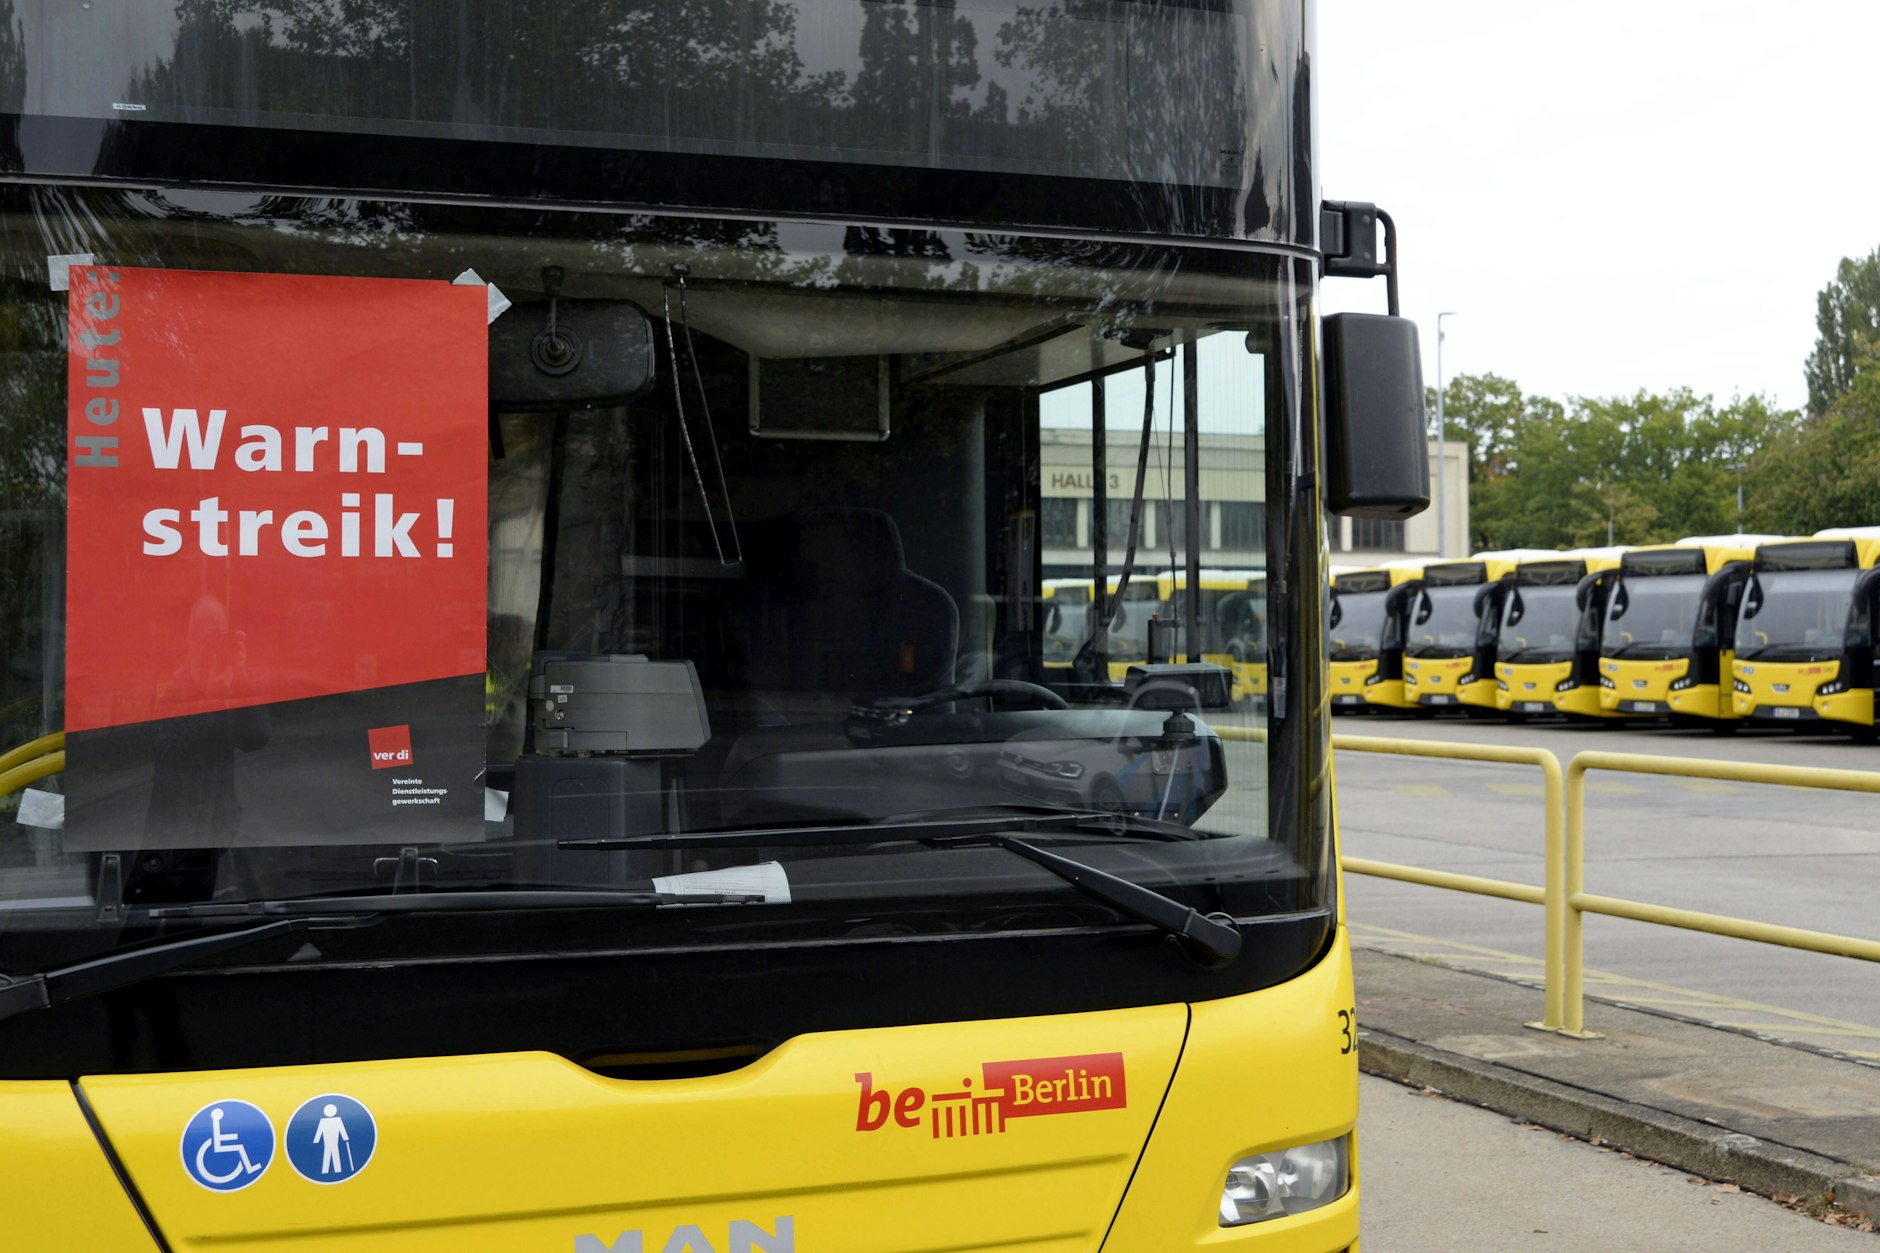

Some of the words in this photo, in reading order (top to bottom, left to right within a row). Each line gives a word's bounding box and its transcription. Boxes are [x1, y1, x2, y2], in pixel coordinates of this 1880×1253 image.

[74, 271, 121, 467] Heute:
[142, 407, 423, 473] Warn-
[1051, 473, 1094, 489] HALL
[1109, 474, 1119, 489] 3
[142, 493, 454, 558] streik!
[392, 797, 441, 806] gewerkschaft
[1011, 1069, 1112, 1106] Berlin
